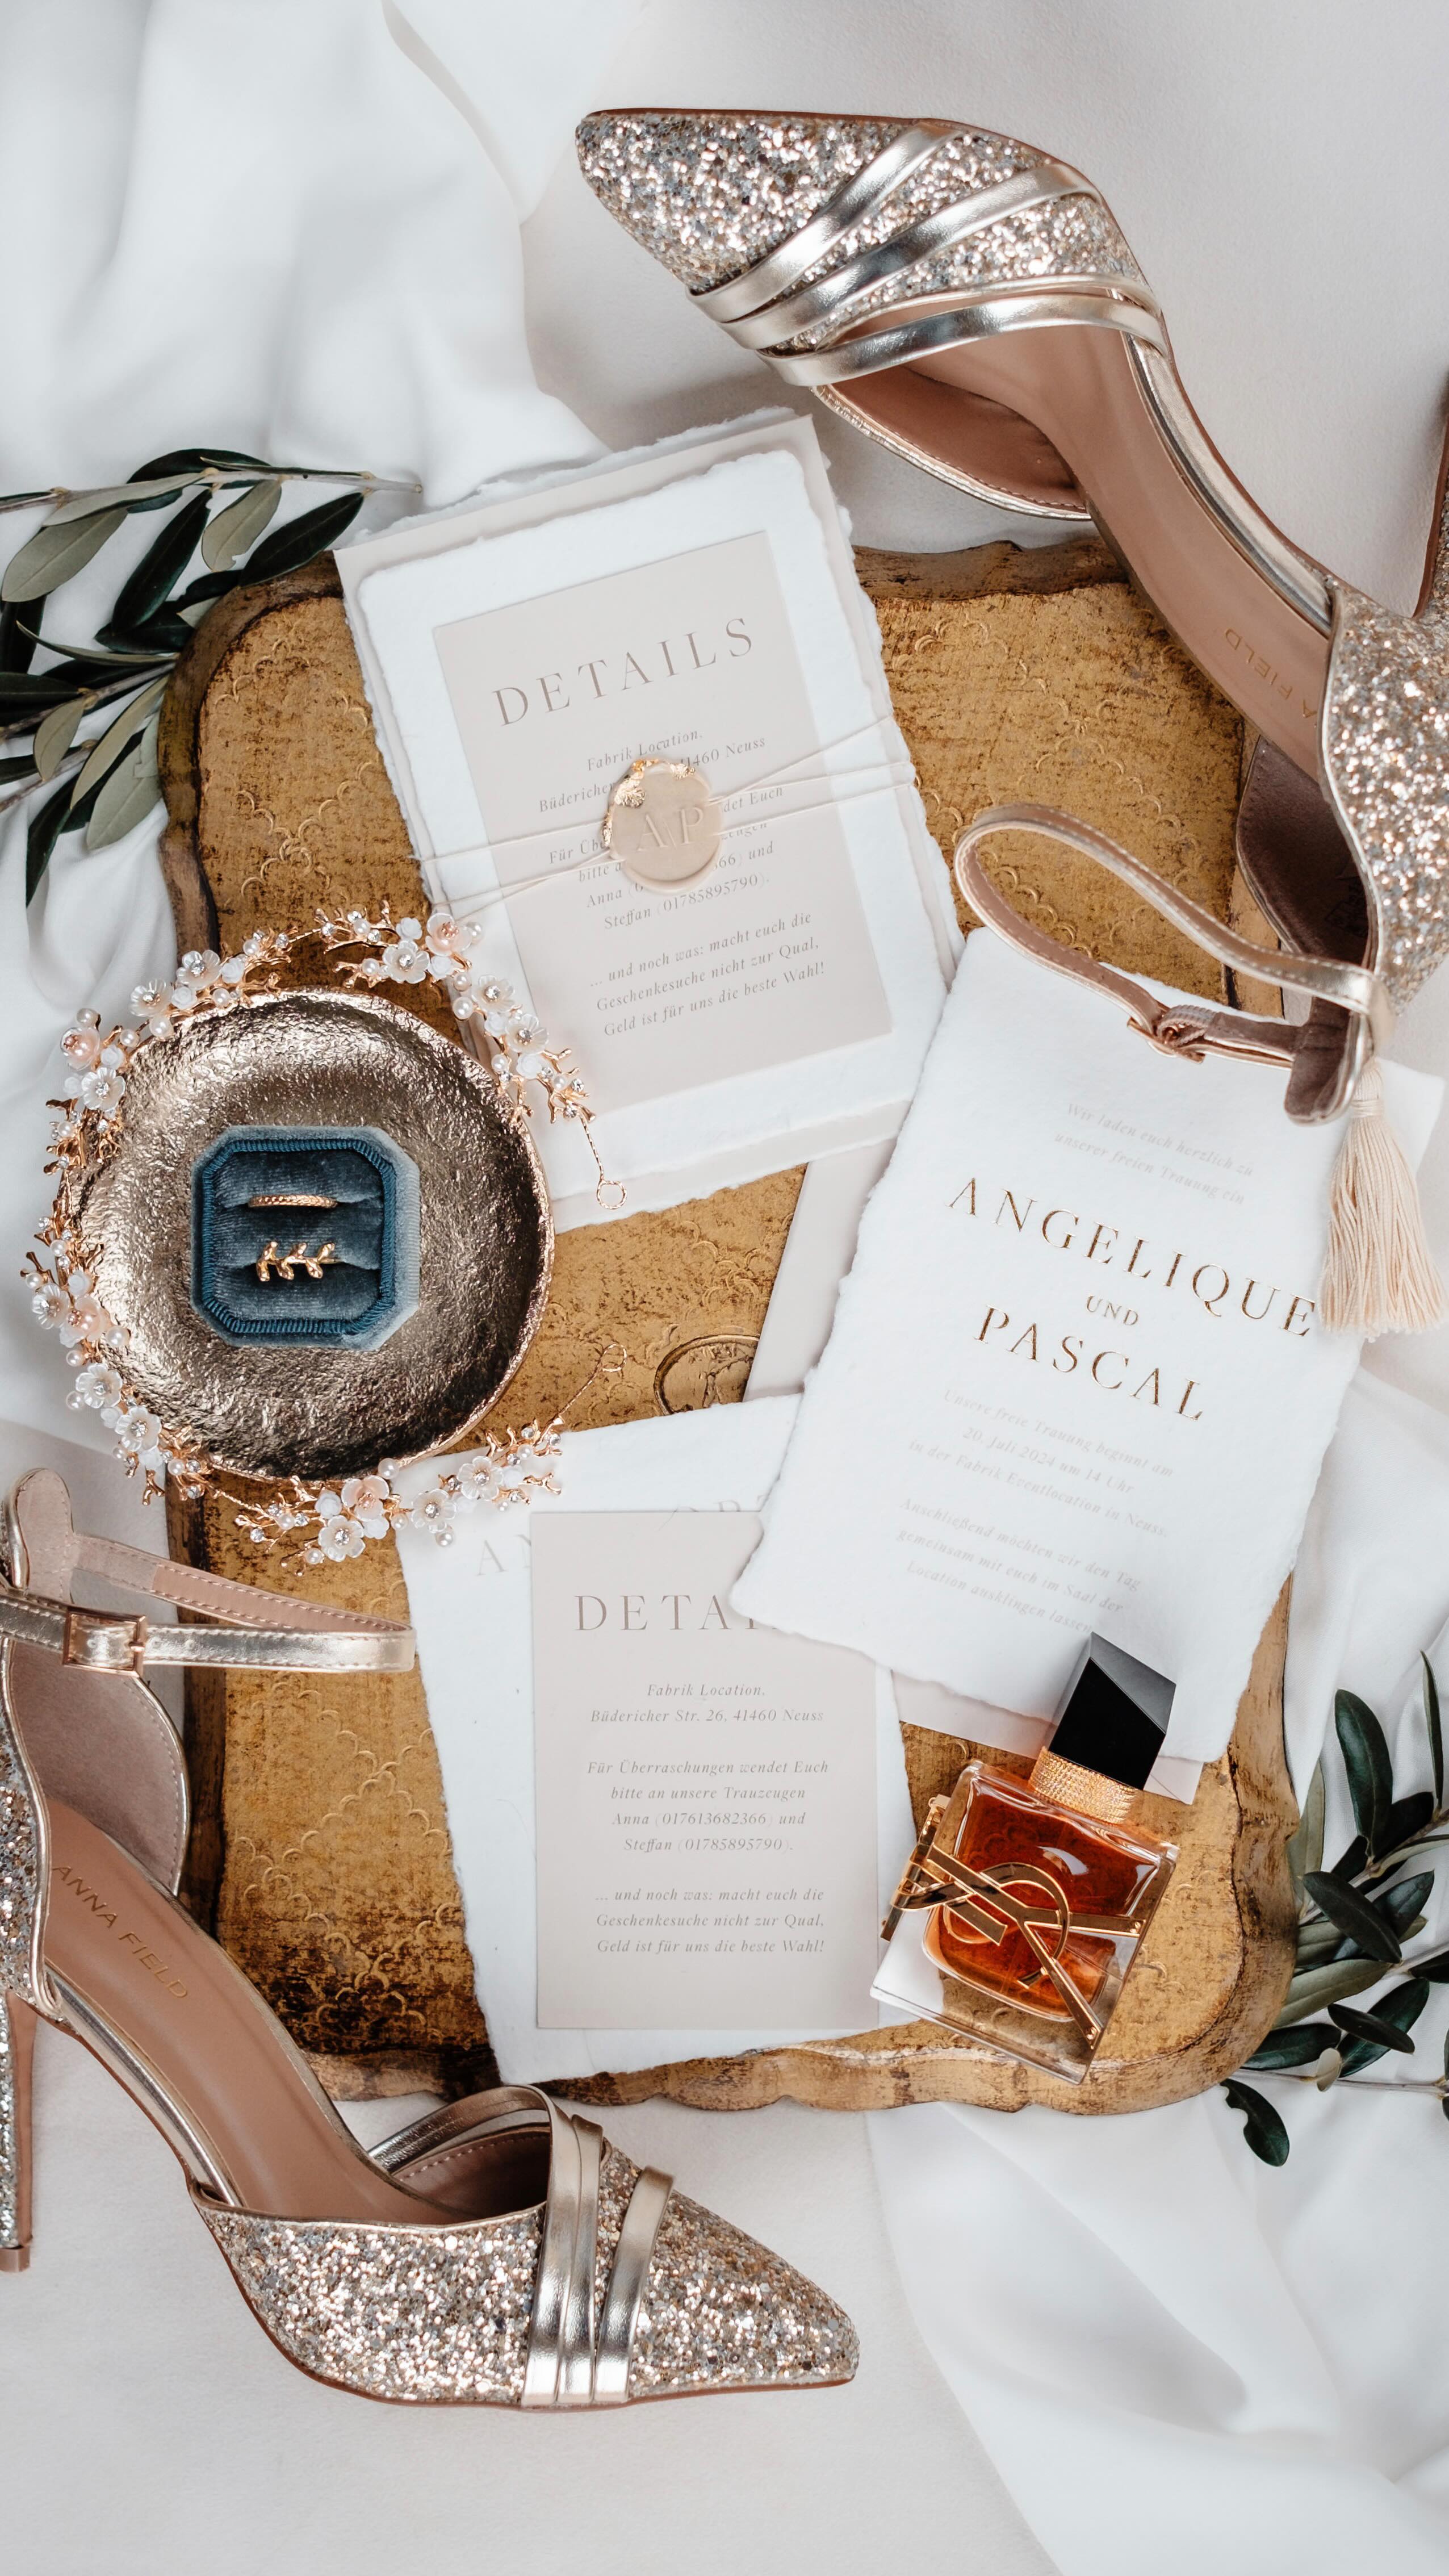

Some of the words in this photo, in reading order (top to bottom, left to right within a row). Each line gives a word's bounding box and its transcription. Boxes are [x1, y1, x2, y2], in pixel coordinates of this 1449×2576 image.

[492, 617, 752, 727] DETAILS
[1225, 628, 1293, 700] FIELD
[587, 748, 633, 771] Fabrik
[680, 750, 719, 768] 1460
[725, 737, 765, 758] Neuss
[549, 848, 574, 864] Für
[587, 889, 622, 908] Anna
[748, 840, 774, 860] und
[604, 908, 651, 929] Steffan
[608, 961, 633, 982] und
[639, 952, 669, 972] noch
[675, 946, 703, 962] was:
[709, 930, 749, 952] macht
[755, 918, 786, 939] euch
[791, 913, 811, 928] die
[596, 971, 706, 1011] Geschenkesuche
[711, 958, 746, 979] nicht
[751, 952, 774, 967] zur
[778, 936, 819, 960] Qual,
[604, 1015, 636, 1036] Geld
[642, 1011, 658, 1026] ist
[662, 1005, 684, 1024] für
[690, 997, 714, 1012] uns
[718, 988, 739, 1003] die
[744, 978, 777, 996] beste
[782, 961, 824, 984] Wahl!
[944, 1177, 1316, 1337] ANGELIQUE
[1085, 1295, 1140, 1327] UND
[973, 1305, 1204, 1422] PASCAL
[573, 1594, 777, 1632] DETA
[646, 1683, 694, 1697] Fabrik
[589, 1708, 670, 1722] Büdericher
[674, 1709, 700, 1722] Str.
[705, 1709, 727, 1722] 26,
[732, 1708, 777, 1722] 41460
[782, 1708, 824, 1721] Neuss
[587, 1761, 614, 1774] Für
[619, 1759, 735, 1778] Überraschungen
[739, 1759, 789, 1774] wendet
[793, 1759, 829, 1774] Euch
[610, 1786, 643, 1800] bitte
[647, 1789, 665, 1800] an
[670, 1789, 718, 1800] unsere
[723, 1786, 806, 1803] Trauzeugen
[611, 1812, 650, 1826] Anna
[778, 1811, 806, 1825] und
[623, 1837, 673, 1854] Steffan
[614, 1888, 642, 1901] und
[646, 1887, 678, 1901] noch
[683, 1891, 713, 1901] was:
[718, 1888, 761, 1901] macht
[765, 1887, 798, 1901] euch
[802, 1887, 824, 1901] die
[52, 1866, 119, 1928] ANNA
[118, 1931, 189, 1998] FIELD
[596, 1913, 709, 1927] Geschenkesuche
[713, 1913, 749, 1927] nicht
[753, 1917, 779, 1927] zur
[784, 1913, 824, 1929] Qual,
[596, 1939, 631, 1953] Geld
[635, 1940, 653, 1953] ist
[655, 1939, 680, 1955] für
[685, 1943, 709, 1952] uns
[714, 1939, 736, 1953] die
[740, 1939, 776, 1953] beste
[782, 1939, 824, 1953] Wahl!
